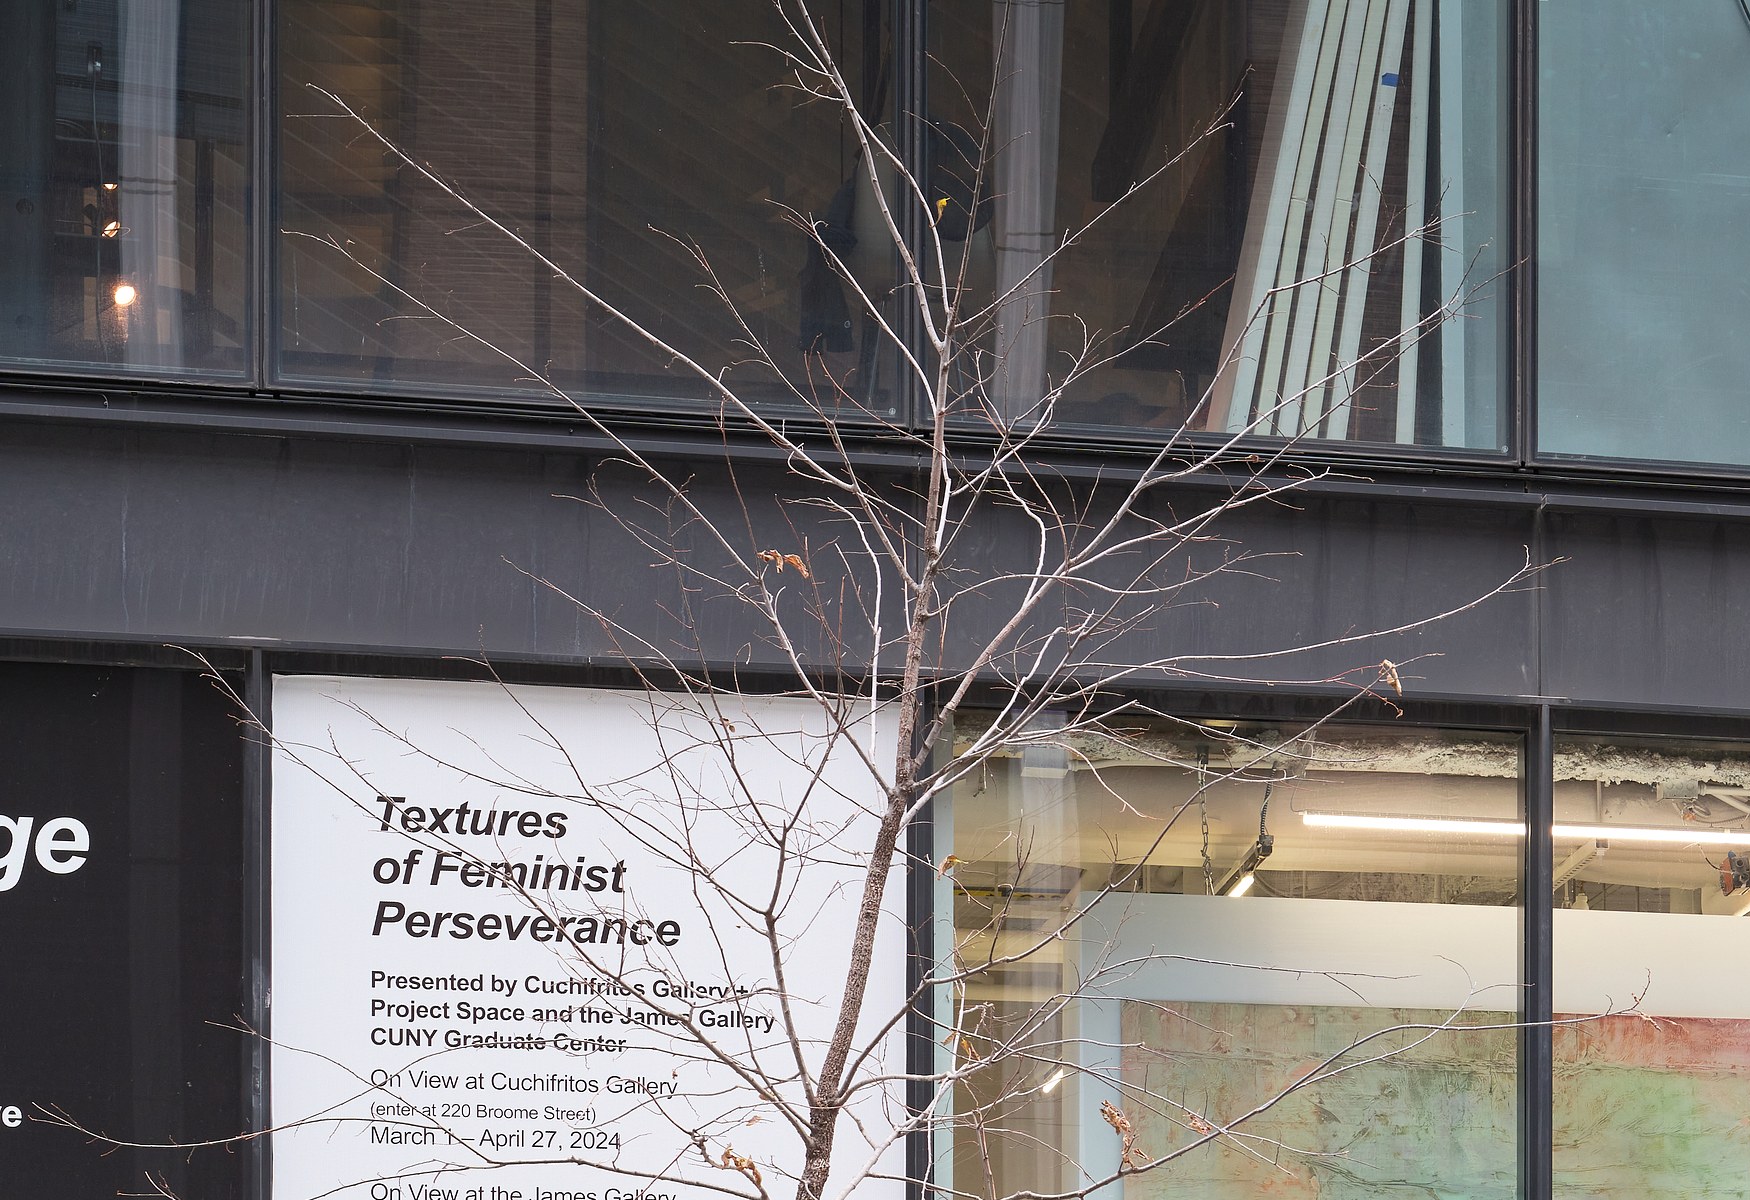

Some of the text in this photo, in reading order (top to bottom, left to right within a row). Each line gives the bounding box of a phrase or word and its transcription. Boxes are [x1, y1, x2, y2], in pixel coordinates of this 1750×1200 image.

[376, 796, 568, 839] Textures
[372, 849, 627, 894] of Feminist
[372, 901, 681, 947] Perseverance
[371, 970, 484, 992] Presented
[491, 975, 518, 997] by
[524, 975, 645, 997] Cuchifritos
[371, 999, 450, 1022] Project
[456, 1001, 525, 1024] Space
[531, 1005, 573, 1022] and
[579, 1006, 614, 1024] the
[699, 1009, 775, 1034] Gallery
[370, 1027, 627, 1052] CUNY Graduate Center
[370, 1069, 678, 1100] On View at Cuchifritos Gallery
[370, 1102, 597, 1124] (enter at 220 Broome Street)
[370, 1126, 435, 1146] March
[479, 1128, 525, 1151] April
[531, 1130, 562, 1151] 27,
[569, 1131, 620, 1150] 2024
